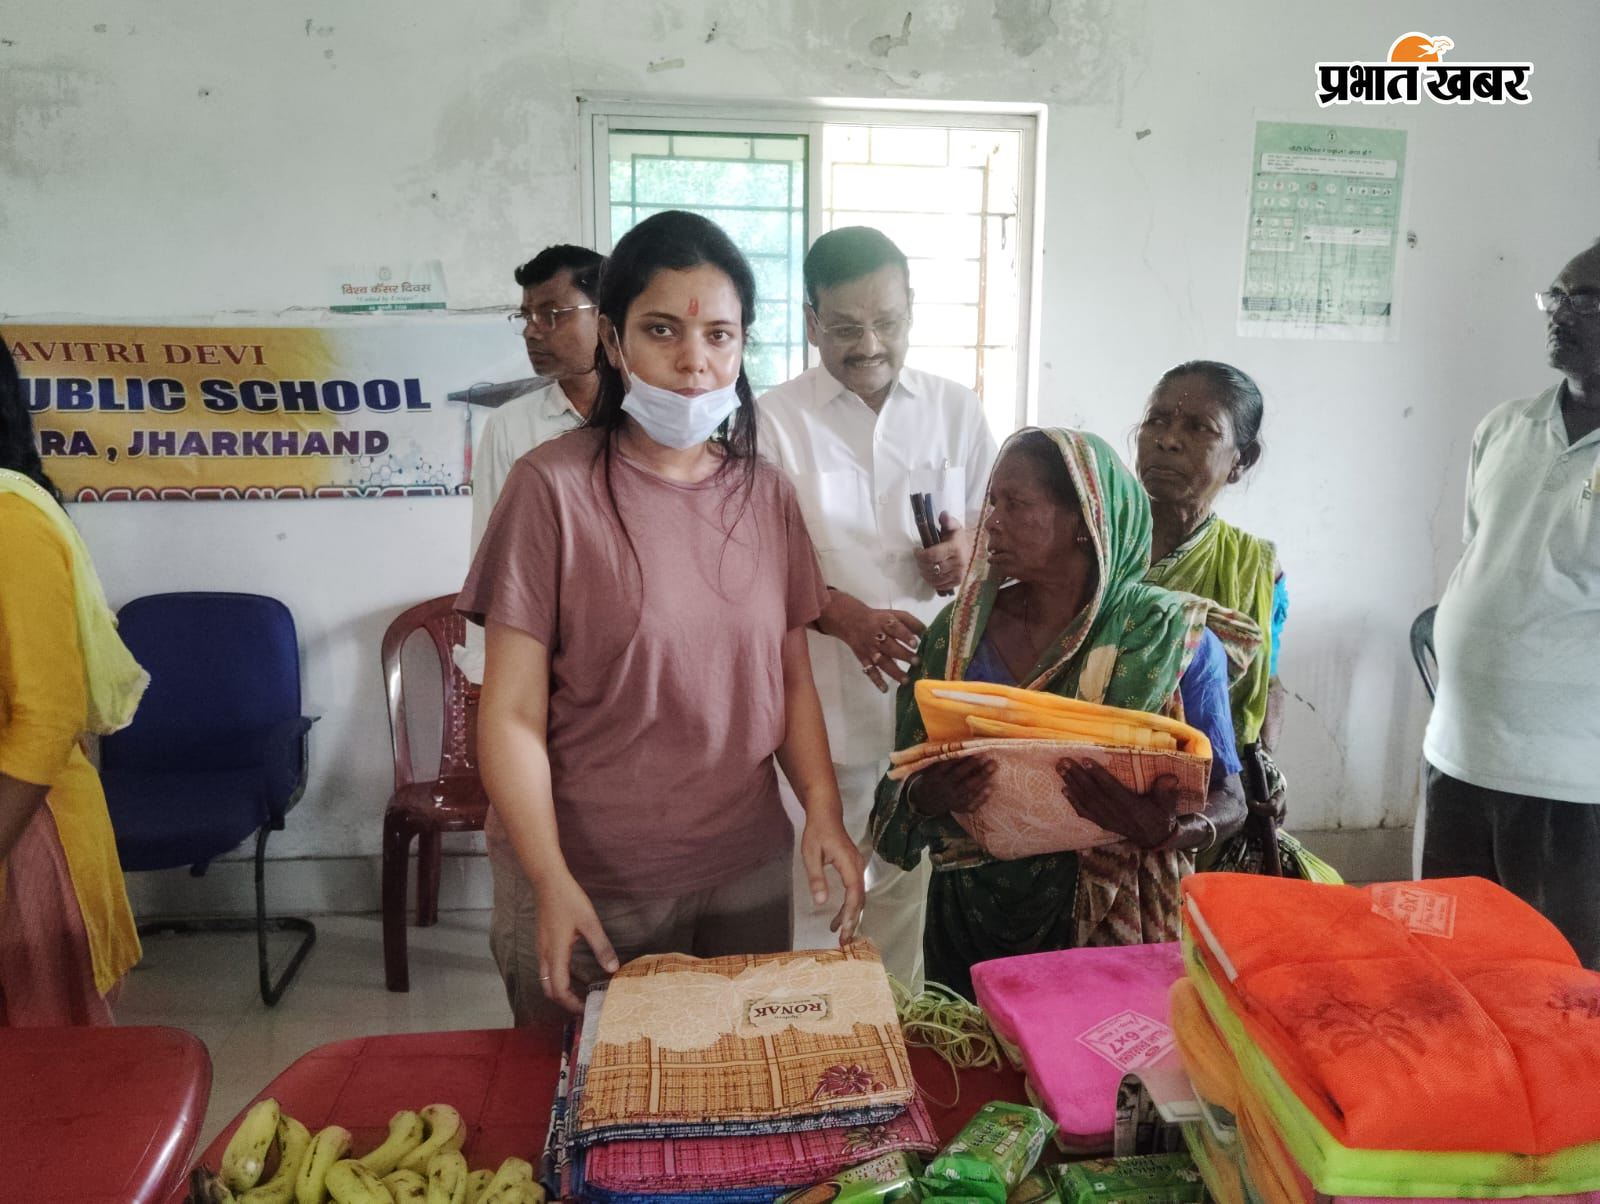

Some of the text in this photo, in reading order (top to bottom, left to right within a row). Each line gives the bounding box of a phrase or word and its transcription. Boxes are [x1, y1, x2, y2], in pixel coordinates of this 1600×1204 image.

[11, 341, 267, 366] AVITRI DEVI
[18, 376, 432, 413] UBLIC SCHOOL
[127, 429, 390, 457] JHARKHAND
[754, 1002, 823, 1018] RONAK
